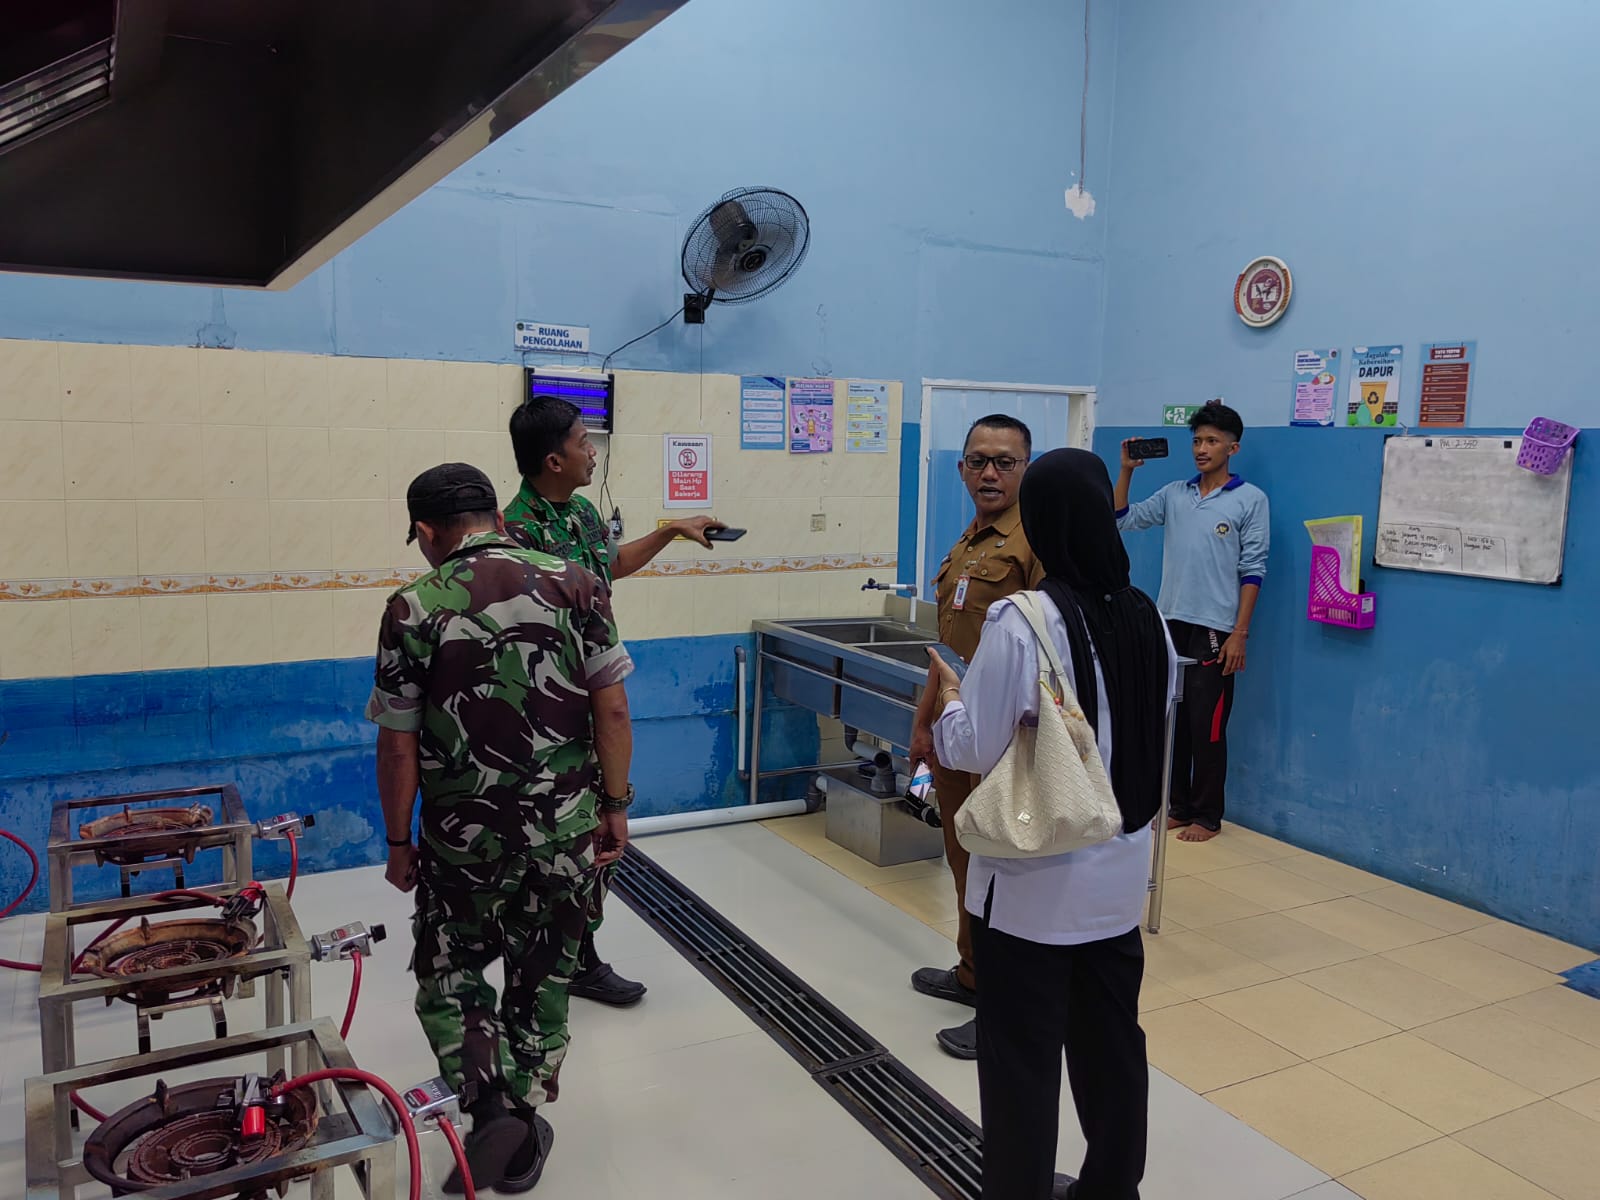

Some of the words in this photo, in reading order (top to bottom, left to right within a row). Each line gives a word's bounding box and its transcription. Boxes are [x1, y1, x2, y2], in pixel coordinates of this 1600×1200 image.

[539, 328, 569, 337] RUANG
[523, 336, 582, 348] PENGOLAHAN
[1358, 366, 1394, 378] DAPUR
